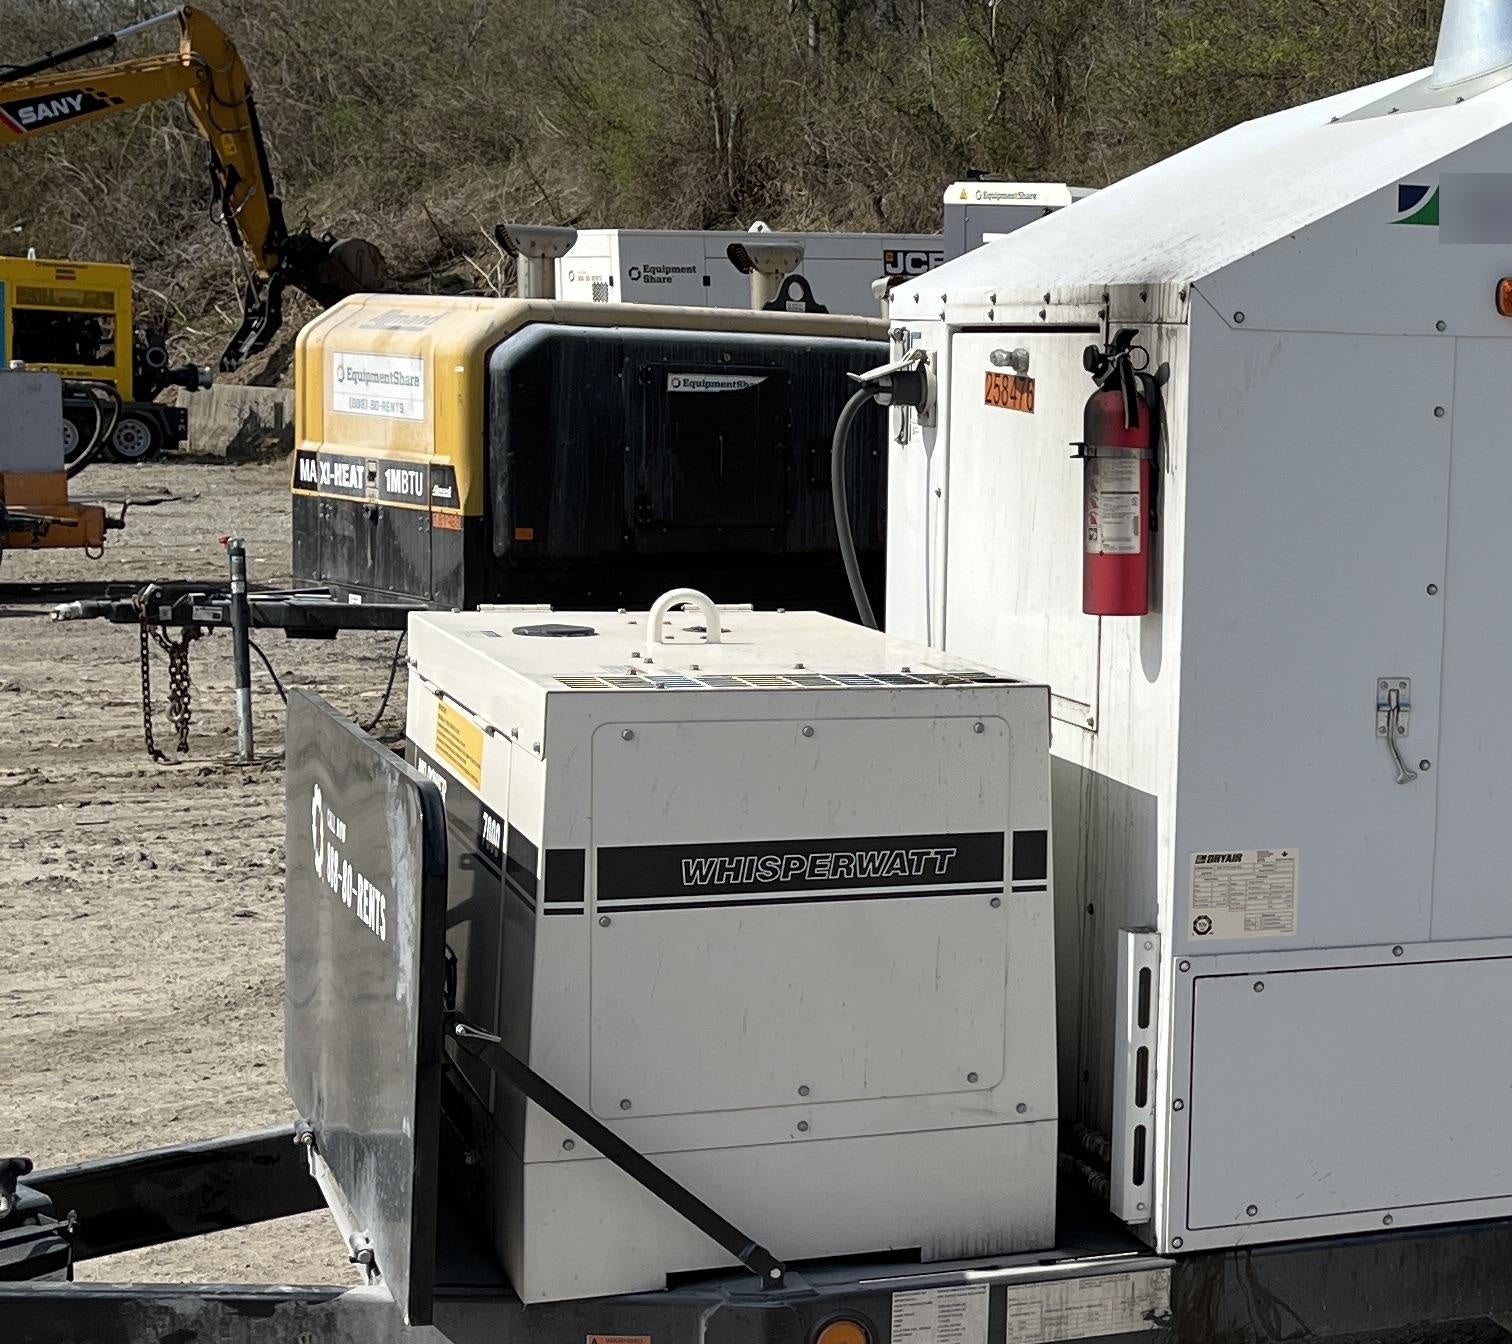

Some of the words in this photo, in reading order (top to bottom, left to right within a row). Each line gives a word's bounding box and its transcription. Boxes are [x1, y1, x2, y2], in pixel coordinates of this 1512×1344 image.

[18, 94, 83, 125] SANY
[643, 264, 697, 275] Equipment
[643, 275, 673, 284] Share
[346, 366, 420, 387] EquipmentShare
[985, 371, 1035, 412] 258476
[384, 467, 423, 497] 1MBTU
[681, 847, 957, 886] WHISPERWATT
[1206, 852, 1244, 864] DRYAIR
